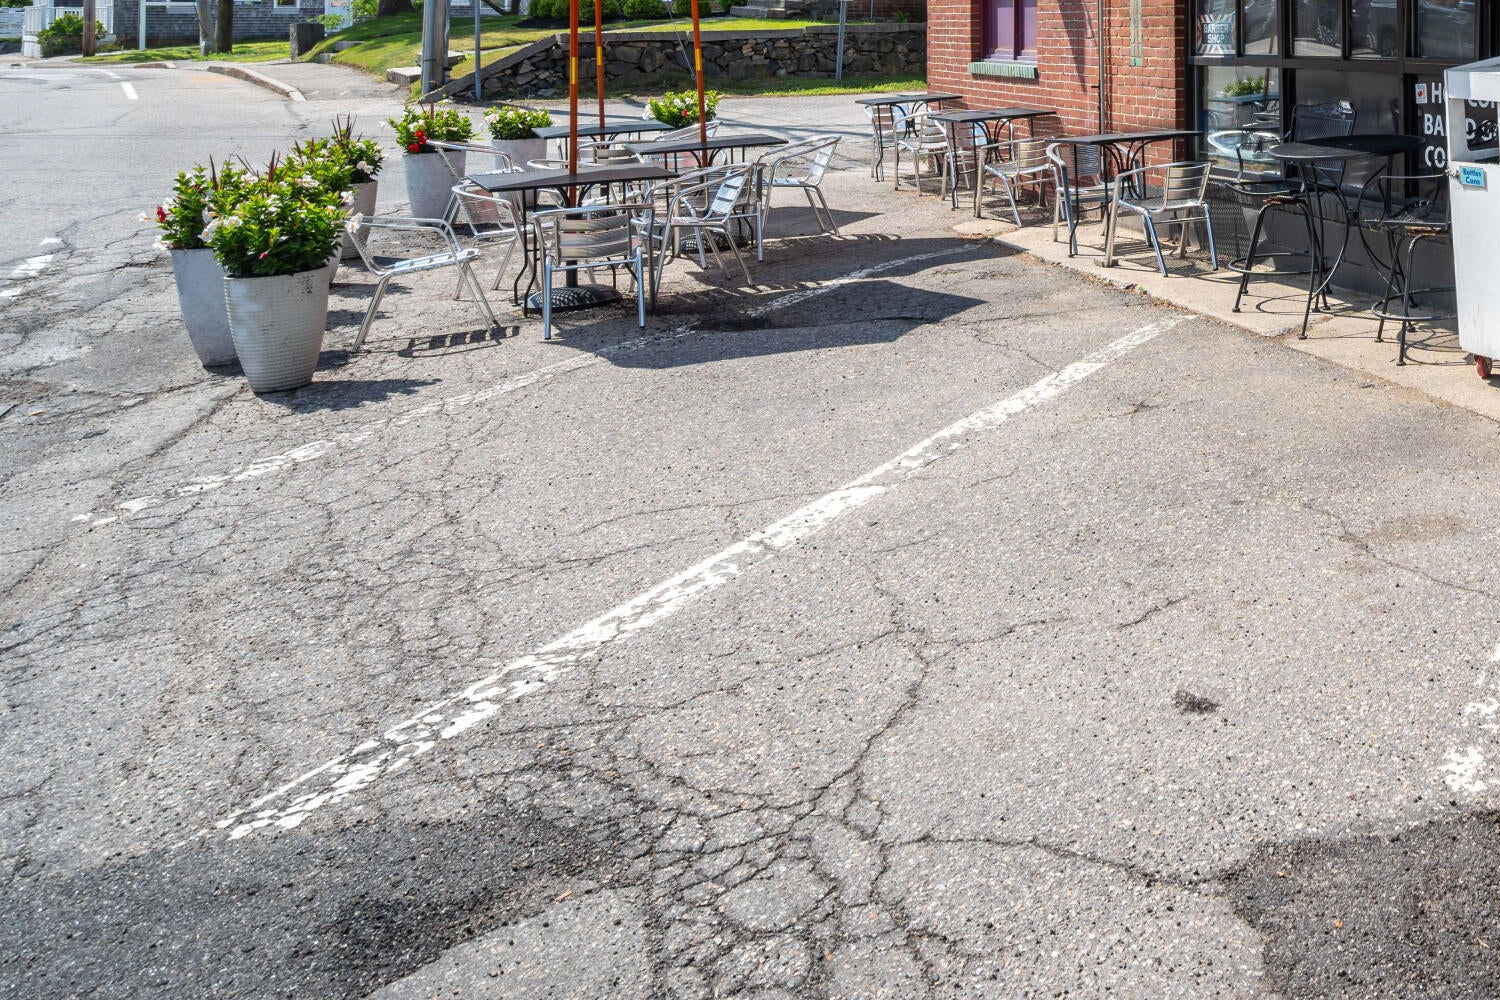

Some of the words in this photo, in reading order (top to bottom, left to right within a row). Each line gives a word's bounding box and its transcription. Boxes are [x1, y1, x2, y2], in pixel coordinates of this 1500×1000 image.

[1203, 22, 1229, 34] BARBER
[1207, 33, 1225, 44] SHOP
[1462, 168, 1482, 177] Bottles
[1465, 177, 1480, 185] Cans
